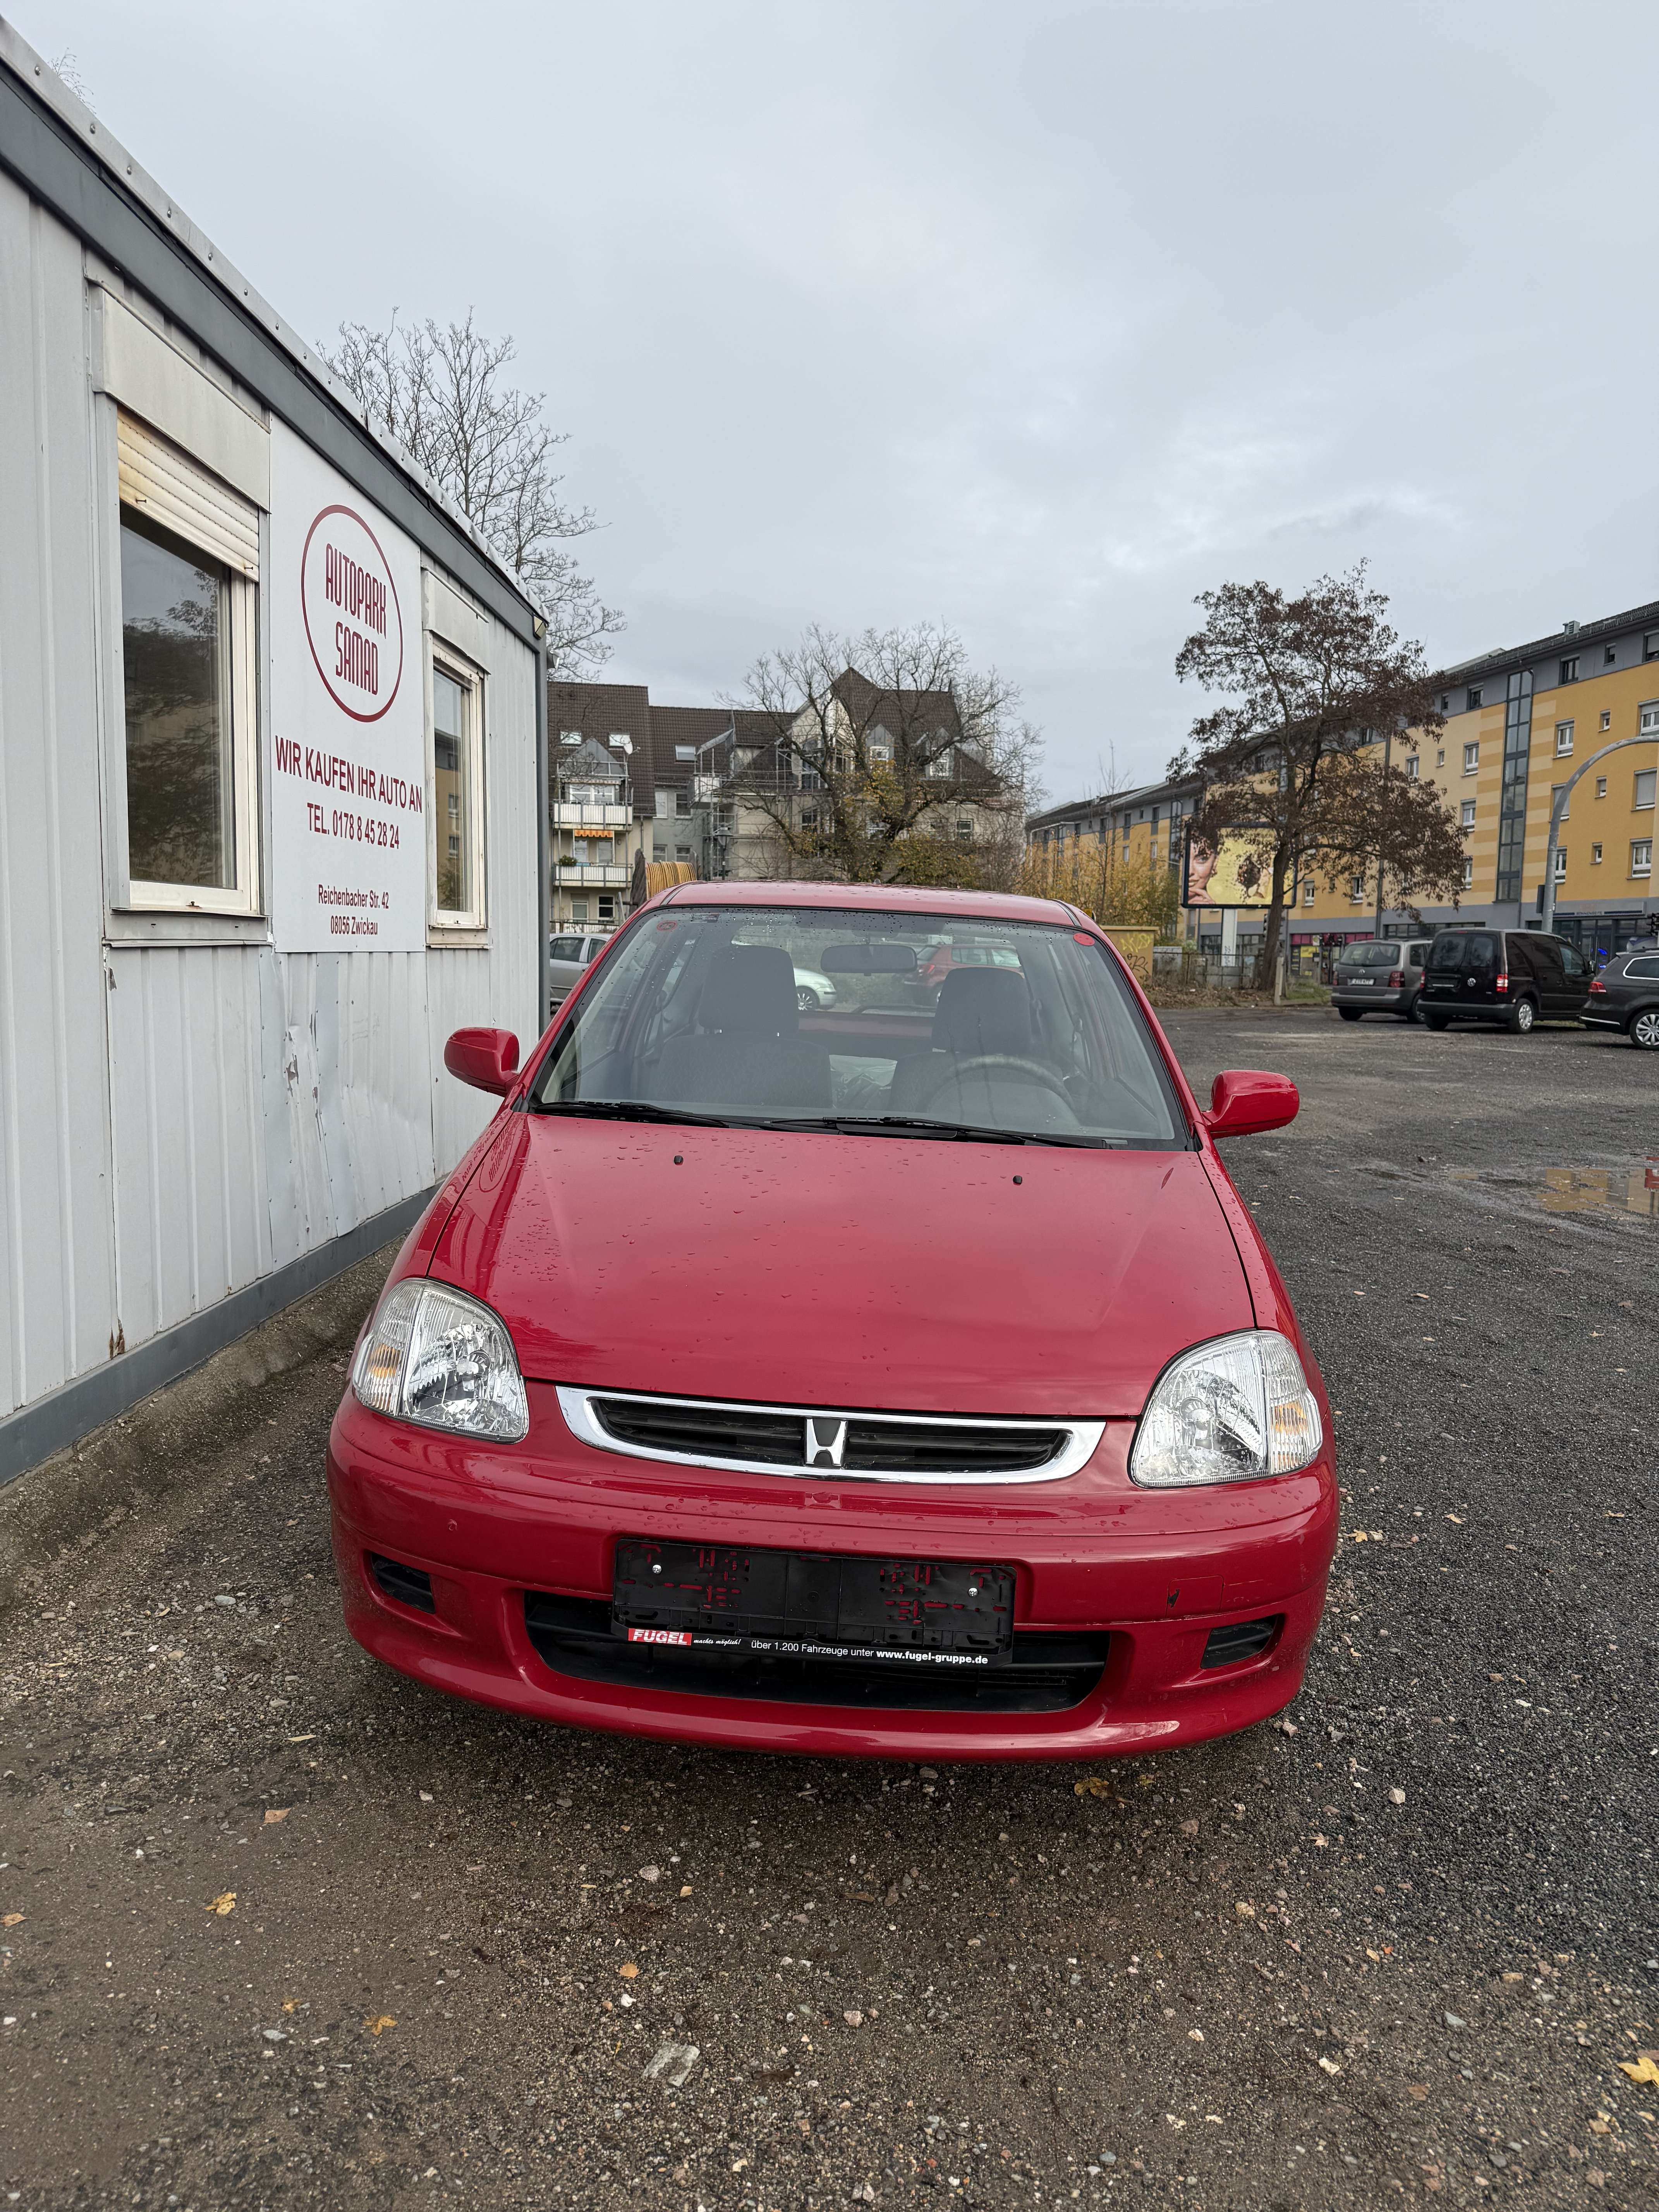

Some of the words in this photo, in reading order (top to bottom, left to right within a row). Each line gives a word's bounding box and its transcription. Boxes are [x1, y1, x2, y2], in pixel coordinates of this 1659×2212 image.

[326, 543, 386, 639] AUTOPARK
[336, 622, 378, 695] SAMAD
[275, 735, 302, 778] WIR
[306, 747, 354, 793] KAUFEN
[358, 766, 376, 800] IHR
[379, 774, 406, 808] AUTO
[409, 784, 422, 813] AN
[307, 802, 329, 835] TEL.
[333, 810, 354, 840] 0178
[357, 816, 362, 842] 8
[365, 818, 375, 844] 45
[378, 821, 387, 847] 28
[390, 824, 399, 849] 24
[319, 884, 368, 907] Reichenbacher
[370, 890, 380, 908] Str.
[382, 891, 389, 909] 42
[331, 915, 350, 934] 08056
[352, 916, 378, 935] Zwickau
[633, 1629, 687, 1645] FUGEL
[751, 1640, 771, 1649] über
[775, 1642, 799, 1651] 1.200
[802, 1644, 848, 1657] Fahrzeuge
[876, 1651, 988, 1664] www.fugel-gruppe.de
